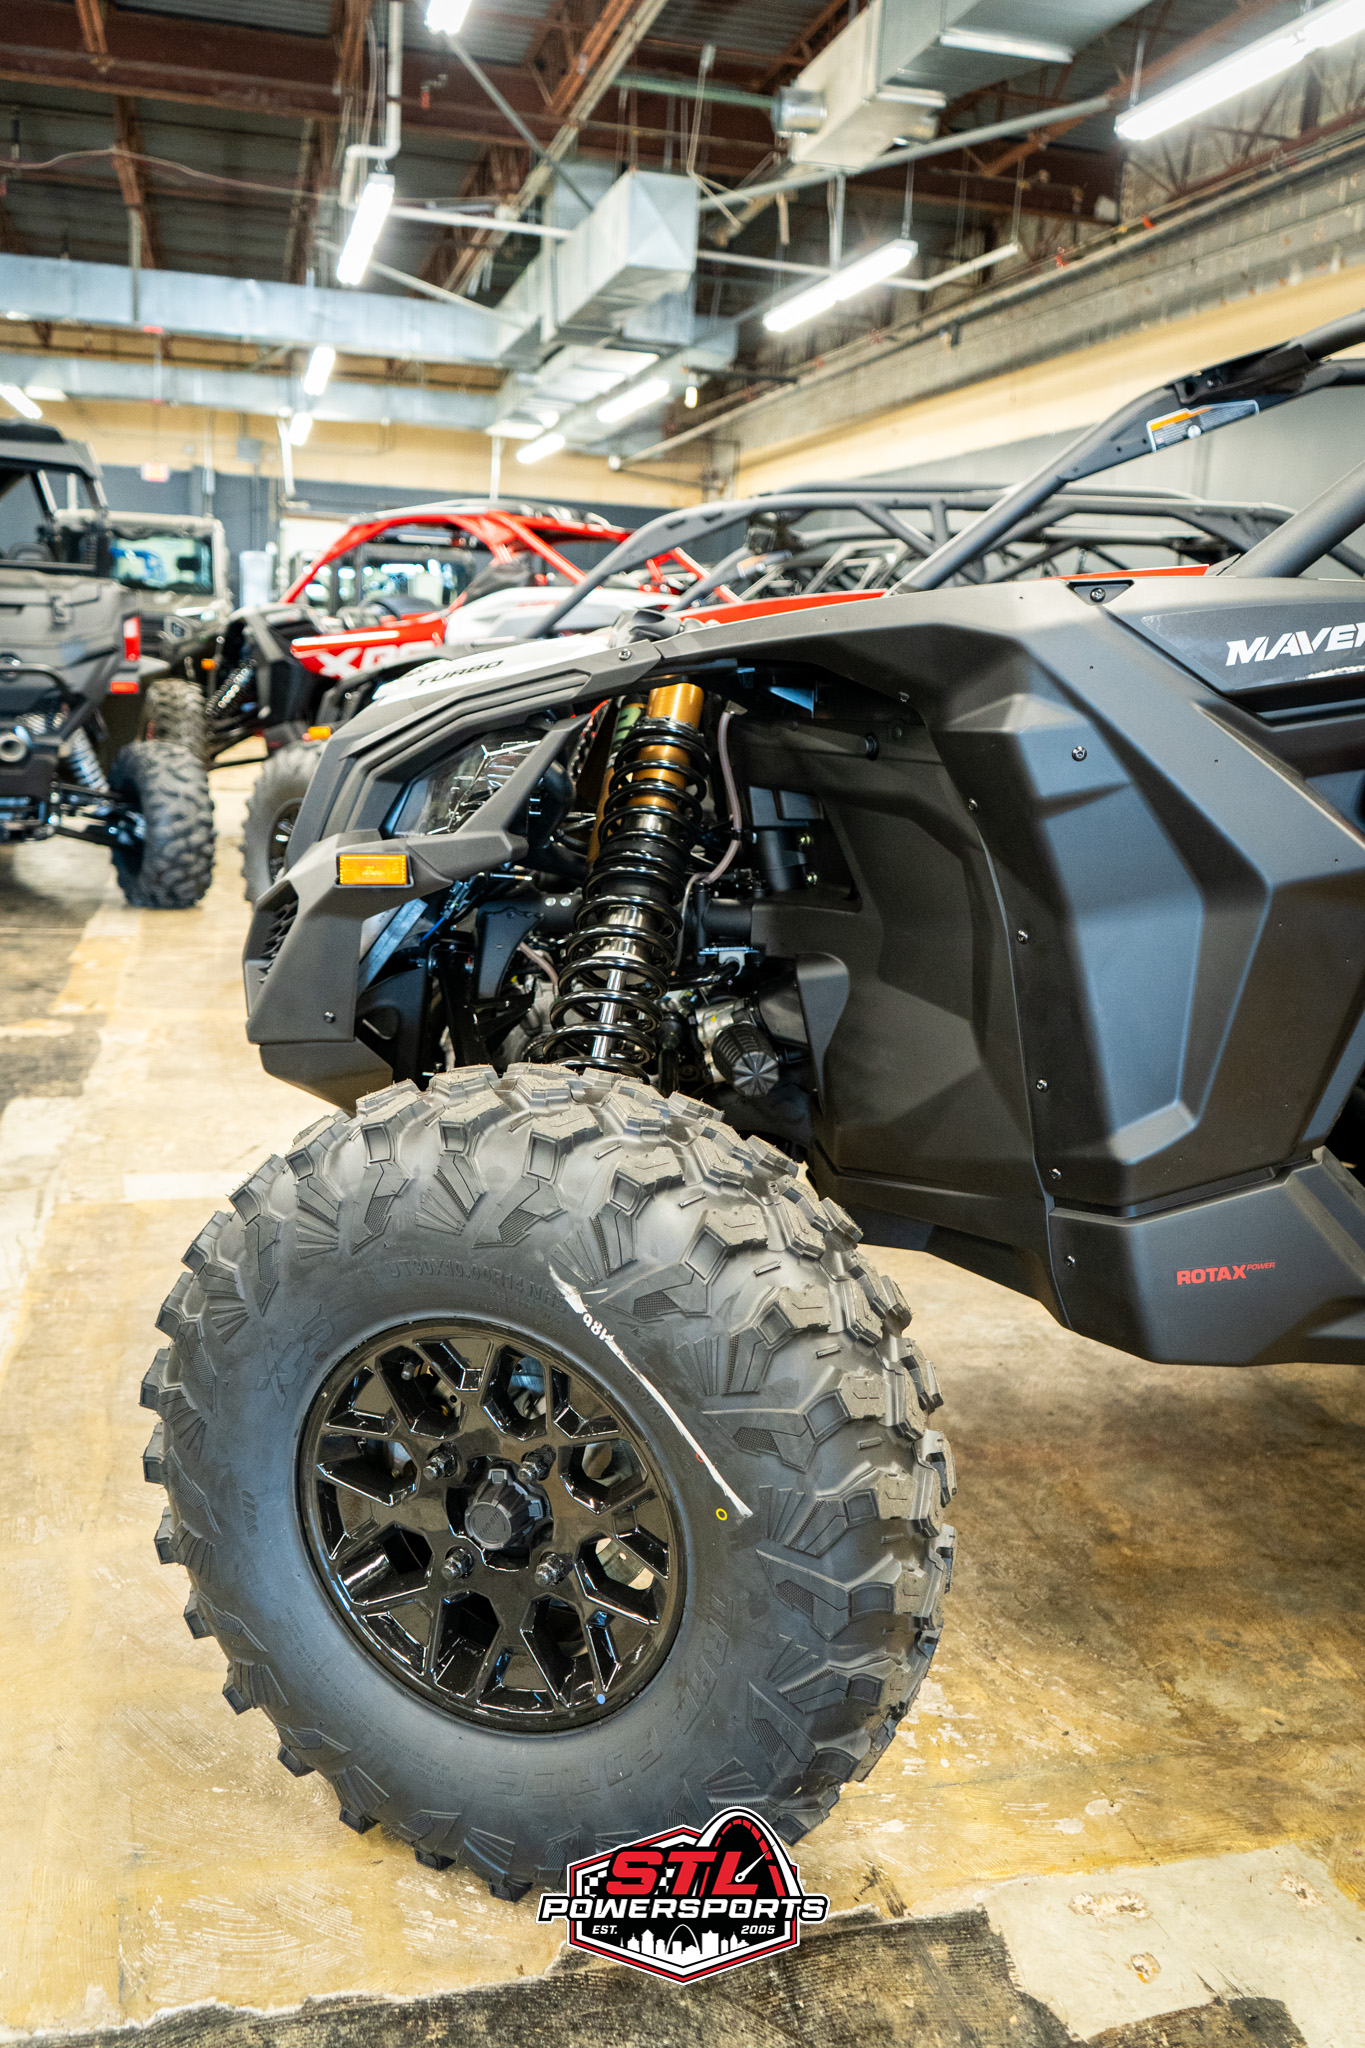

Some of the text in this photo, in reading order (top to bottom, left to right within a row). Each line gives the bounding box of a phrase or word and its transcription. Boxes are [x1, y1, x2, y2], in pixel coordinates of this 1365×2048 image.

[417, 660, 504, 687] TURBO
[1177, 1262, 1275, 1285] ROTAX POWER
